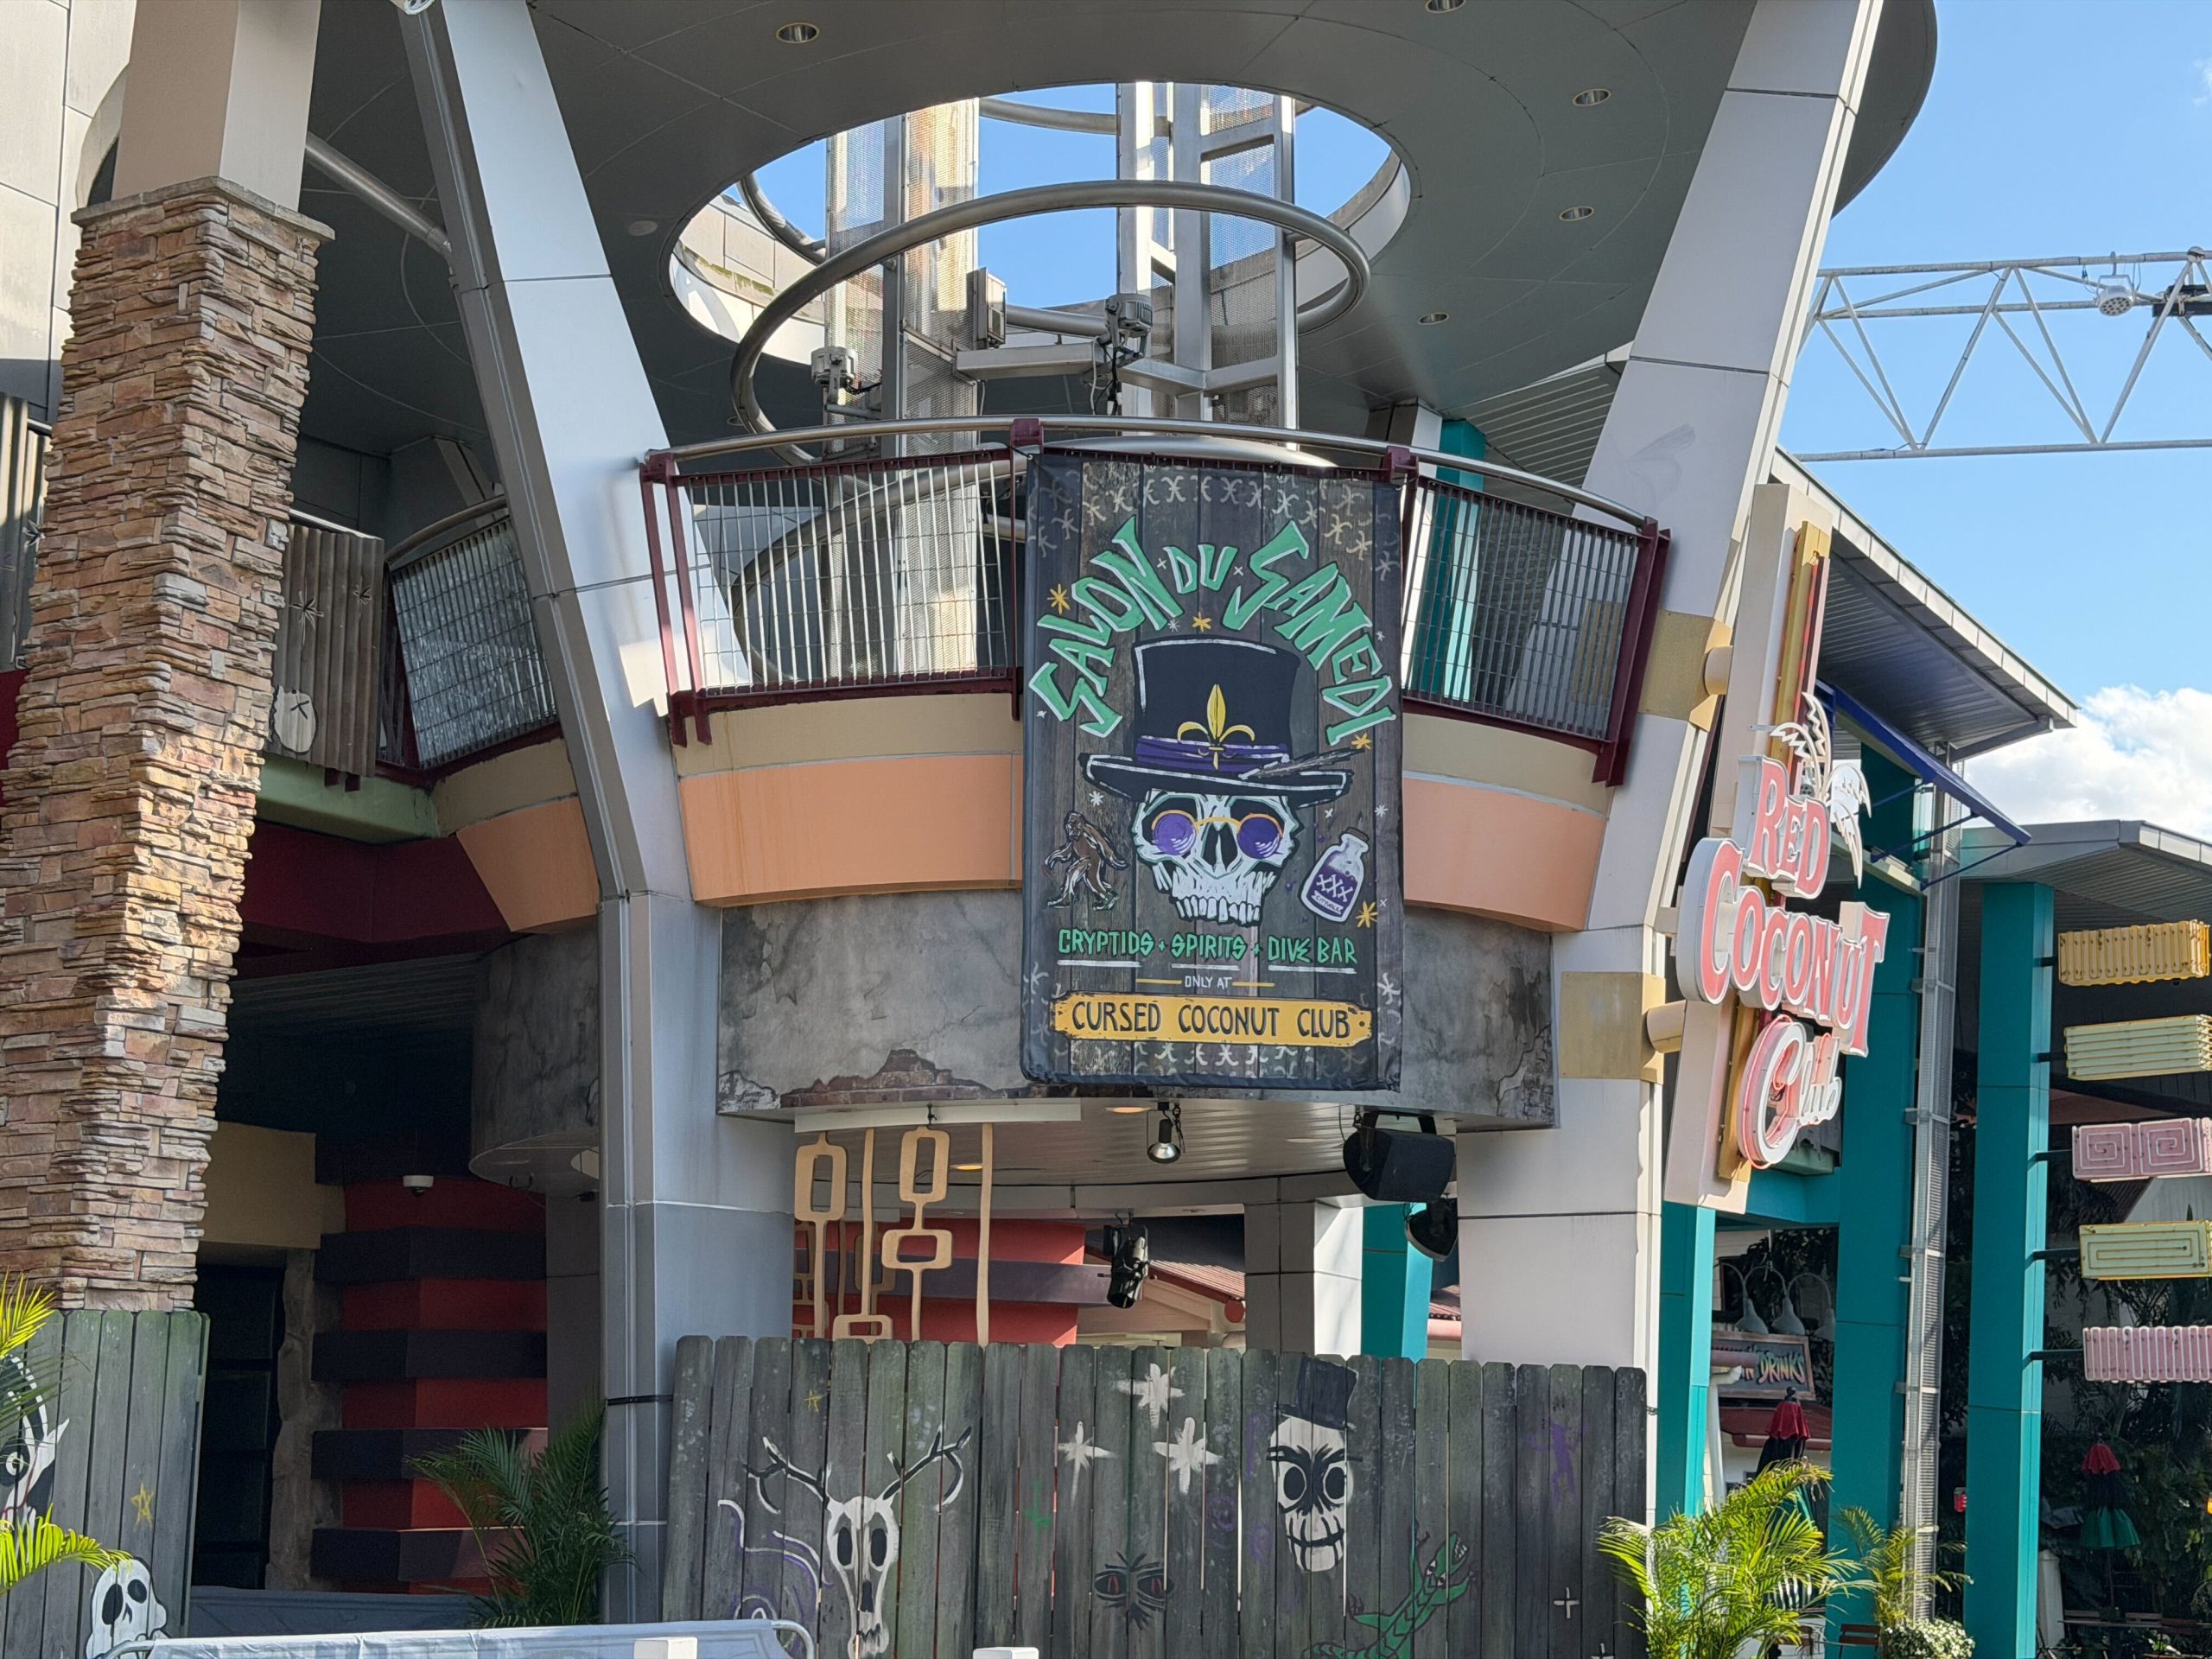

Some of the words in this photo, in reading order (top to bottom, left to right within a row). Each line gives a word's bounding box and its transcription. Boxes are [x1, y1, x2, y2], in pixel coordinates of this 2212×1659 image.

[1028, 515, 1185, 739] SALON
[1162, 543, 1238, 595] DU
[1222, 520, 1396, 747] SAMEDI
[1747, 756, 1828, 899] RED
[1058, 928, 1154, 957] CRYPTIDS
[1171, 933, 1247, 961] SPIRITS
[1268, 936, 1312, 963] DIVE
[1317, 938, 1357, 965] BAR
[1185, 976, 1212, 989] ONLY
[1217, 976, 1233, 989] AT
[1700, 836, 1891, 1058] COCONUT
[1071, 1001, 1161, 1033] CURSED
[1178, 1005, 1280, 1037] COCONUT
[1297, 1008, 1351, 1039] CLUB
[1757, 1021, 1843, 1165] Club
[1758, 1351, 1805, 1382] DRINKS
